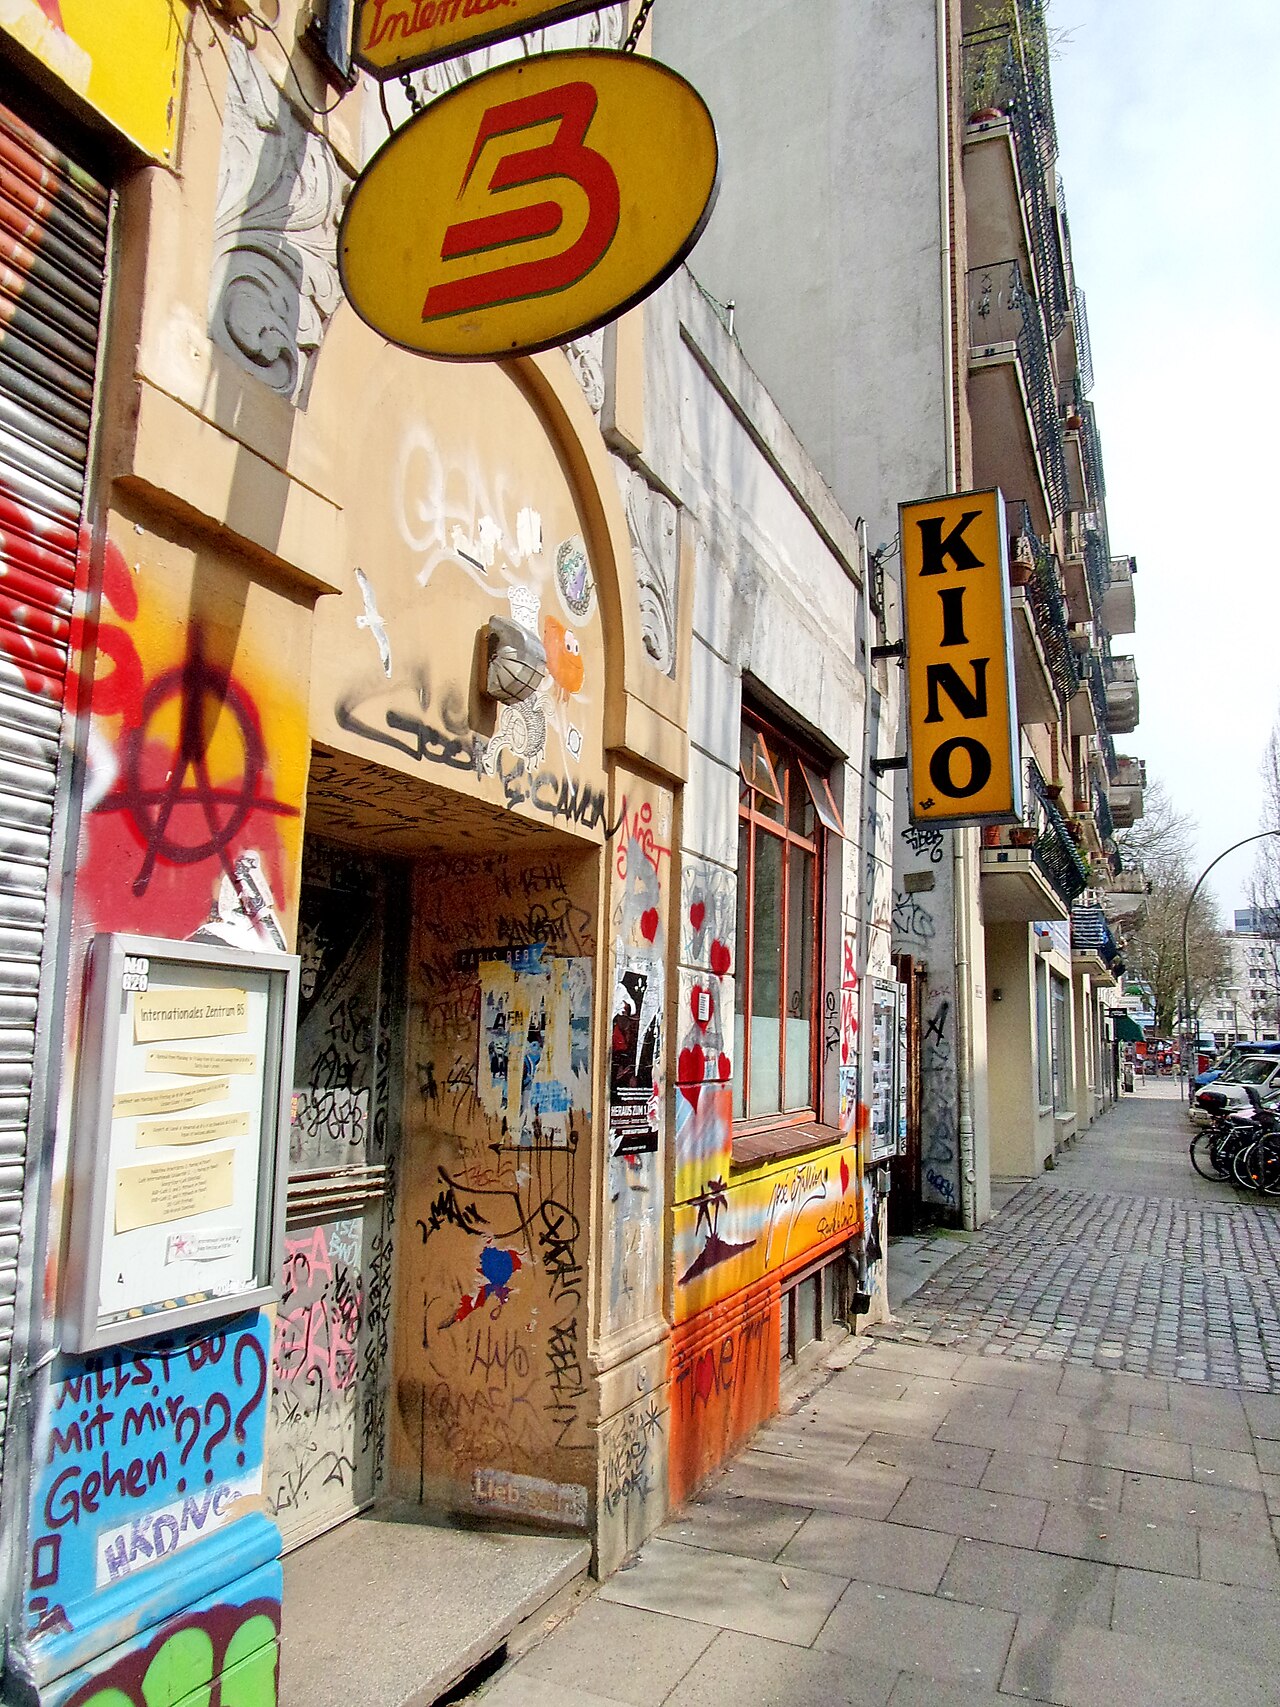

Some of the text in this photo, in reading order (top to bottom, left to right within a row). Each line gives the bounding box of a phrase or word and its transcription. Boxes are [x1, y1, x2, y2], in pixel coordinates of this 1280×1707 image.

[916, 510, 992, 799] KINO
[140, 1004, 203, 1022] Internationales
[206, 1005, 235, 1019] Zentrum
